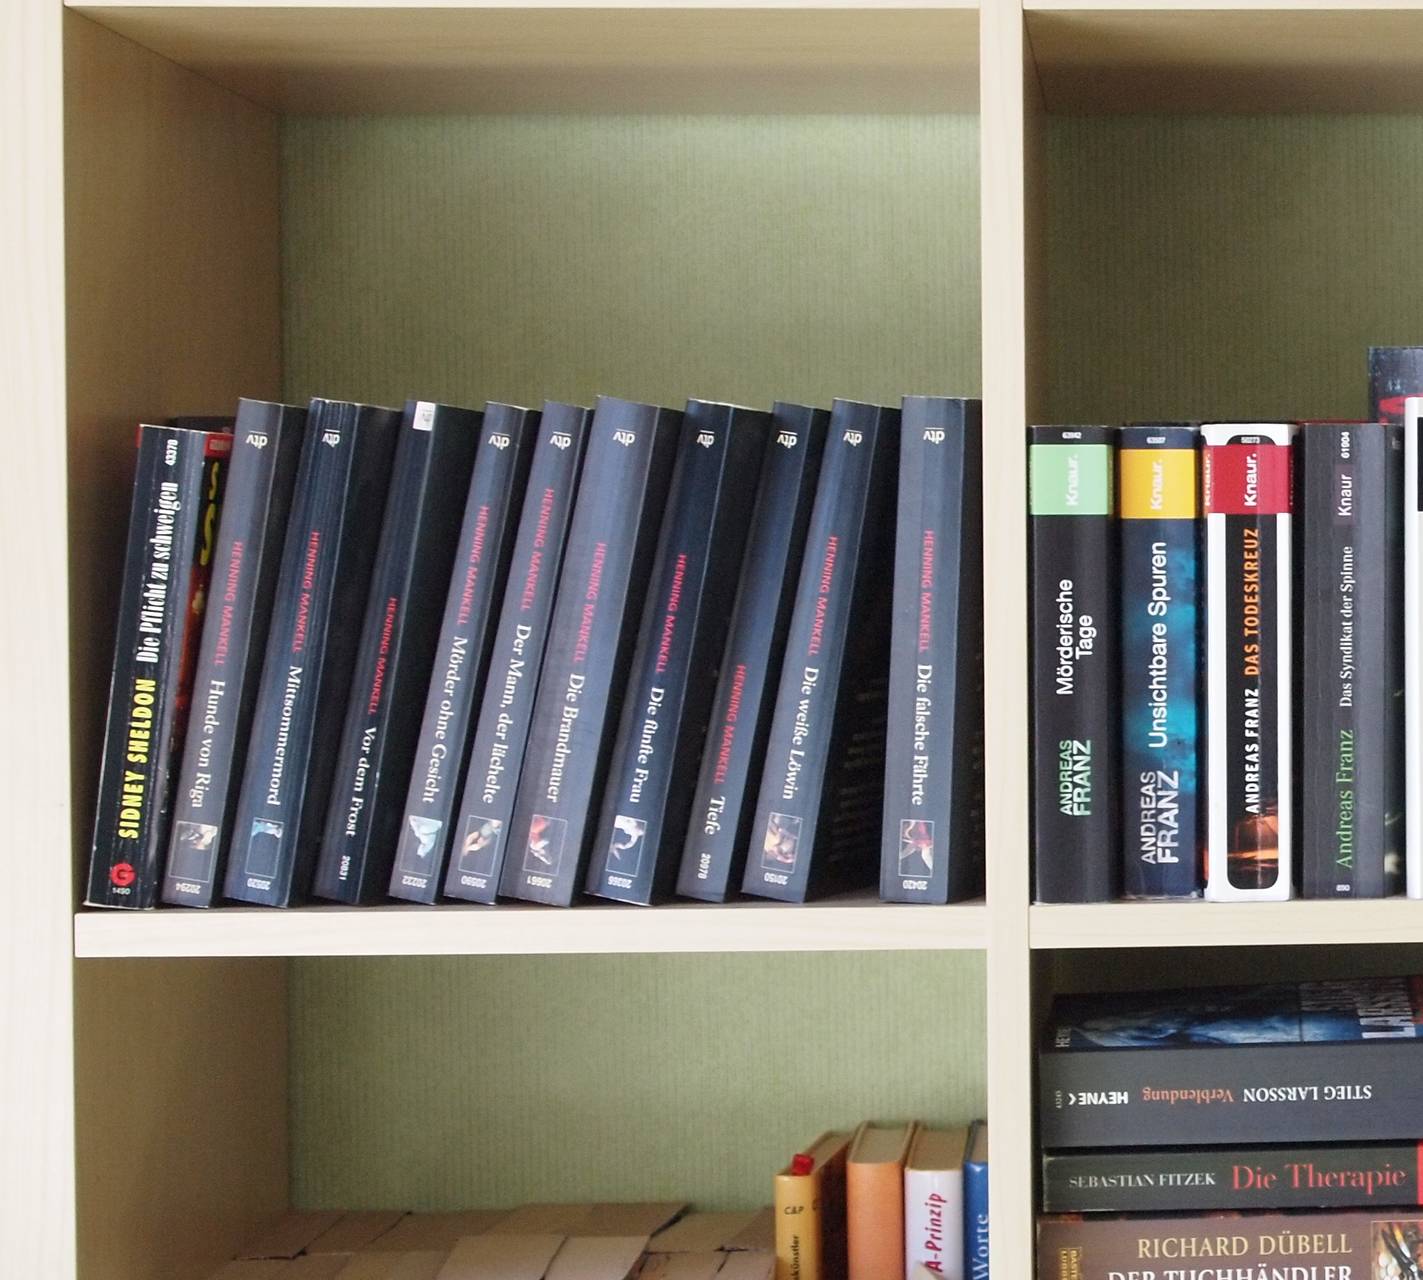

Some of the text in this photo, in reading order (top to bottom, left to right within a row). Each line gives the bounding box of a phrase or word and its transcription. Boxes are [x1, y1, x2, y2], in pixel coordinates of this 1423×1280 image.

[245, 432, 268, 450] dtv
[1338, 473, 1353, 517] Knaur
[1339, 546, 1356, 592] Spinne
[1339, 594, 1353, 620] der
[118, 482, 181, 841] SIDNEY SHELDON Die Pflicht zu schweigen
[188, 541, 243, 808] HENNING MANKELL Hunde von Riga
[266, 530, 320, 807] HENNING MANKELL Mittsommermord
[513, 624, 531, 656] Der
[1056, 578, 1074, 695] Mörderische
[1075, 614, 1097, 660] Tage
[1147, 541, 1171, 748] Unsichtbare Spuren
[1243, 528, 1260, 815] ANDREAS FRANZ DAS TODESKREUZ
[1339, 621, 1356, 679] Syndikat
[345, 597, 397, 837] HENNING MANKELL Vor dem Frost
[422, 635, 468, 803] Mörder ohne Gesicht
[495, 712, 513, 742] der
[1339, 681, 1353, 708] Das
[546, 674, 585, 803] Die Brandmauer
[629, 687, 664, 803] Die fünfte Frau
[782, 667, 819, 800] Die weiße Löwin
[911, 665, 932, 806] Die falsche Fährte
[1335, 728, 1353, 784] Franz
[482, 743, 508, 804] lächelte
[1059, 739, 1073, 816] ANDREAS
[1073, 739, 1092, 816] FRANZ
[704, 796, 725, 836] Tiefe
[1140, 771, 1156, 865] ANDREAS
[1157, 770, 1179, 864] FRANZ
[1335, 789, 1353, 869] Andreas
[1142, 1084, 1372, 1104] STIEG LARSSON Verblendung
[1068, 1163, 1409, 1196] SEBASTIAN FITZEK Die Therapie
[1137, 1230, 1353, 1259] RICHARD DÜBELL
